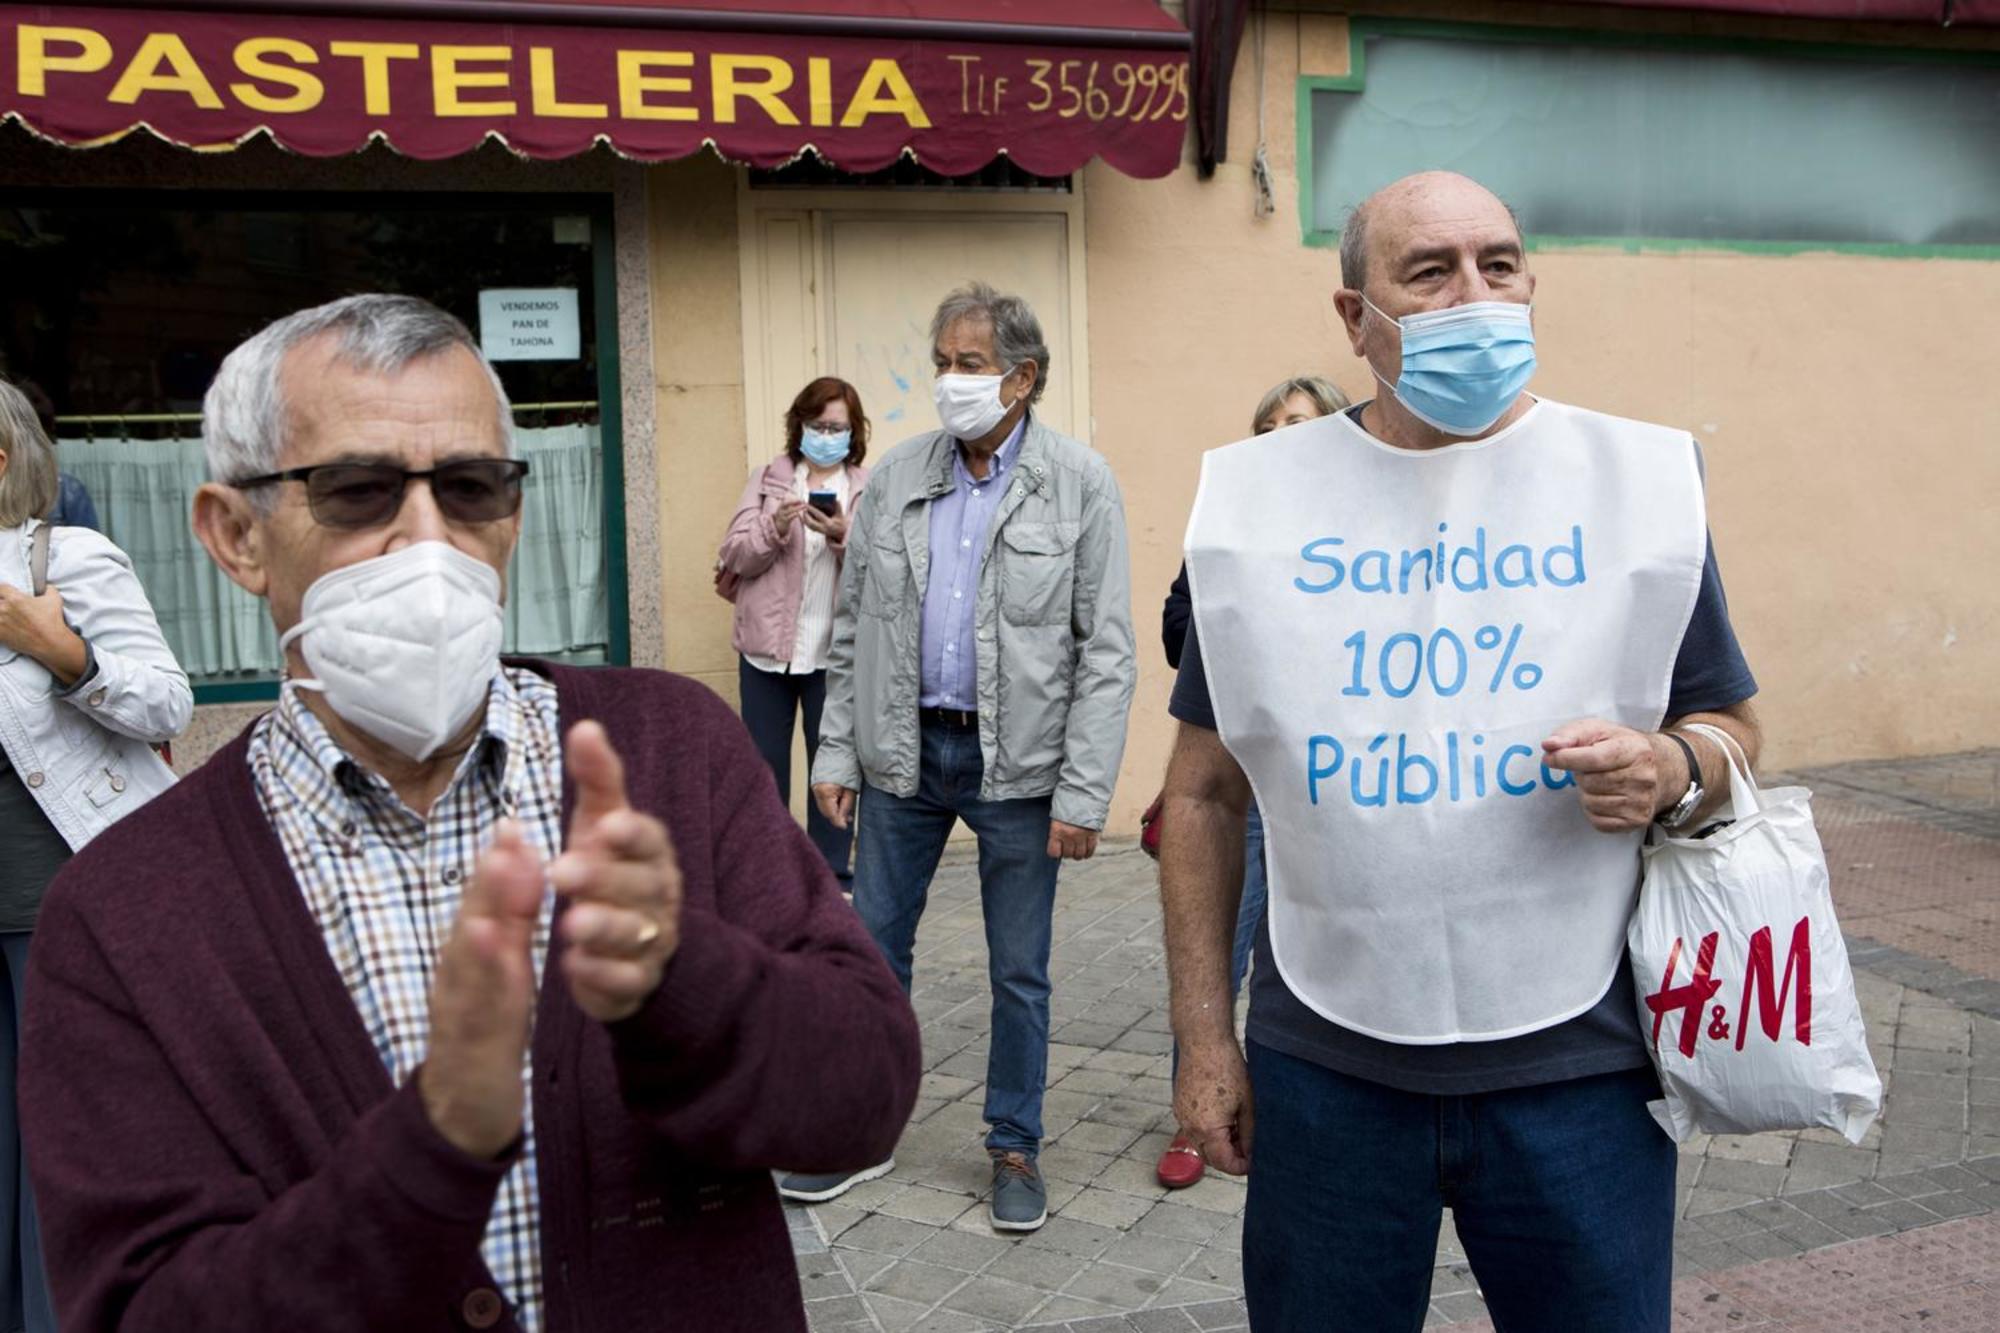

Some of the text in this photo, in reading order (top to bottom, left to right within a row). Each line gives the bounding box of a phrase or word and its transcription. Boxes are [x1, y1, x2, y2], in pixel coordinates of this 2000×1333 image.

[17, 24, 932, 129] PASTELERIA
[501, 302, 560, 312] VENDEMOS
[510, 337, 554, 347] TAHONA
[512, 320, 549, 329] PAN DE
[1293, 522, 1587, 594] Sanidad
[1341, 623, 1543, 699] 100%
[1645, 916, 1812, 1059] H&M
